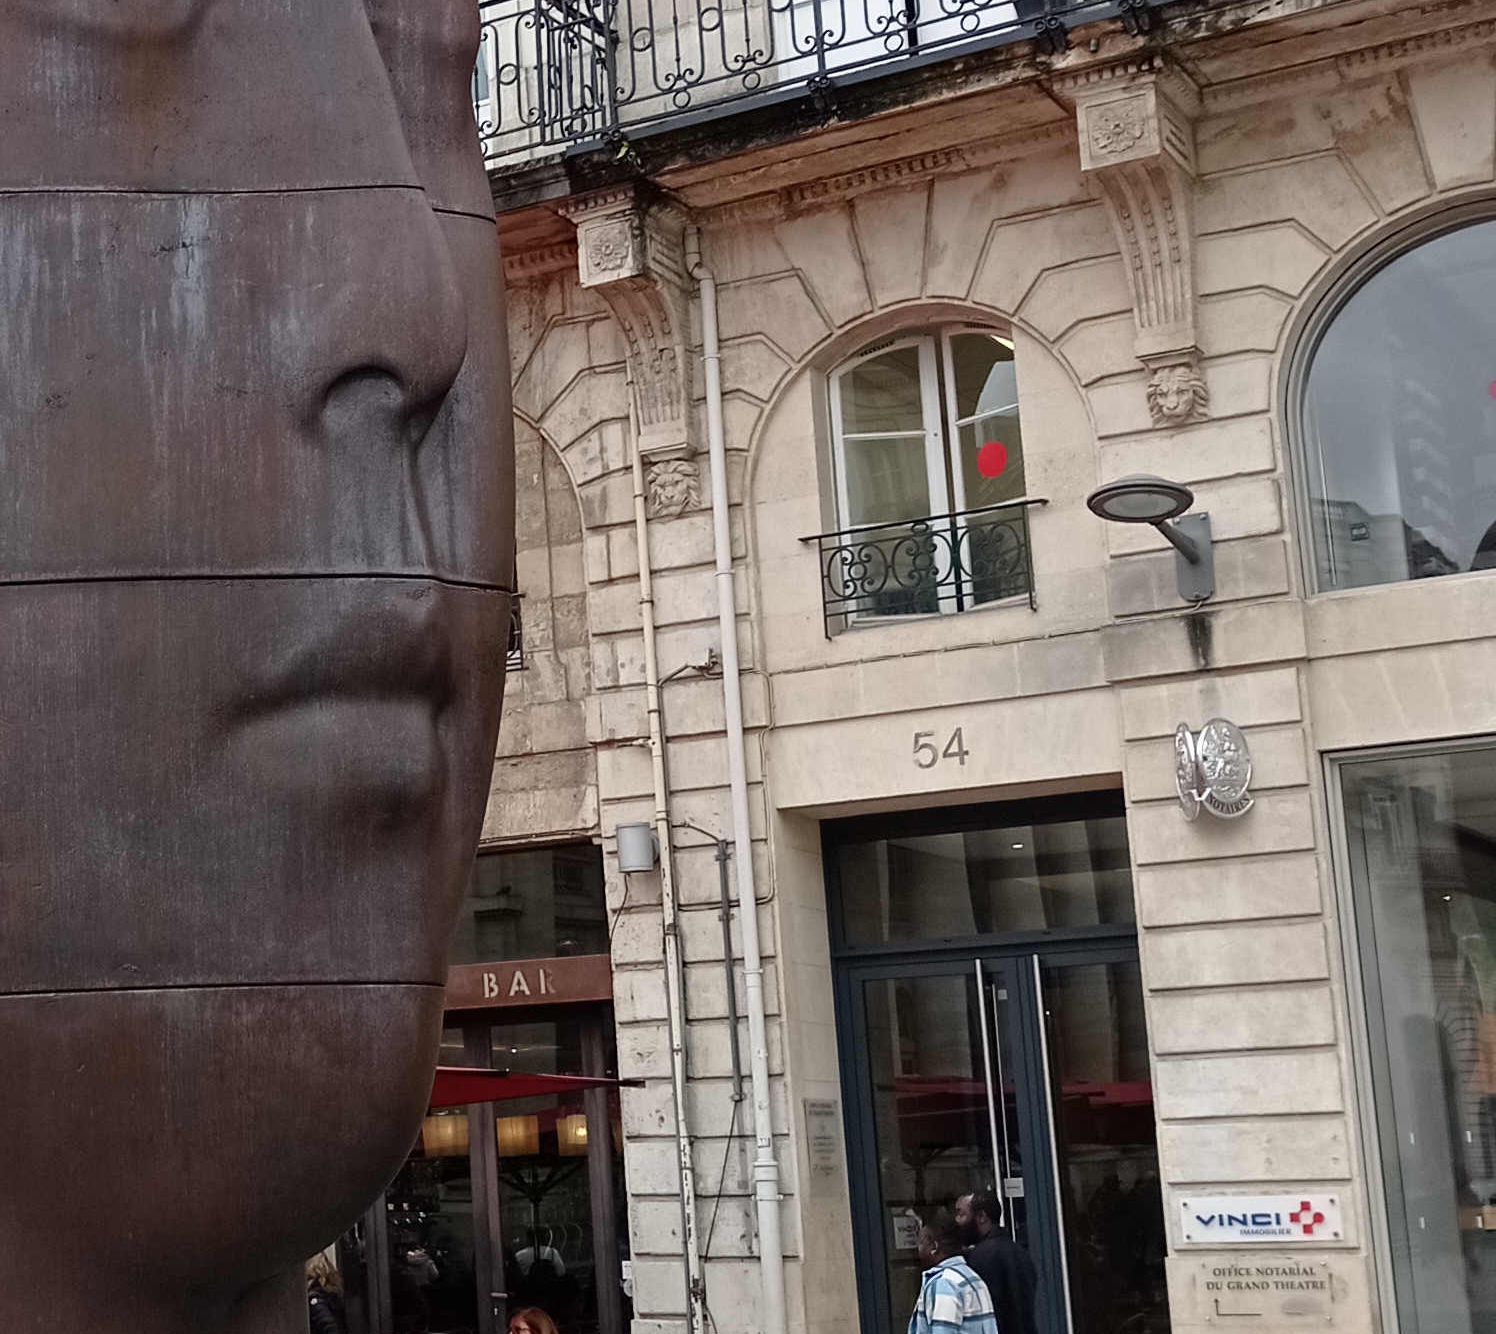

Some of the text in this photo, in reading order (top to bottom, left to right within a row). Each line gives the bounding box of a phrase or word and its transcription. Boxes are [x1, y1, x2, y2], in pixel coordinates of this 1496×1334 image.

[913, 727, 969, 769] 54
[1205, 792, 1251, 814] NOTAIRES
[483, 969, 555, 998] BAR
[1196, 1213, 1281, 1226] VINCI
[1213, 1267, 1316, 1277] OFFICE NOTARIAL
[1206, 1281, 1223, 1290] DU
[1227, 1281, 1270, 1290] GRAND
